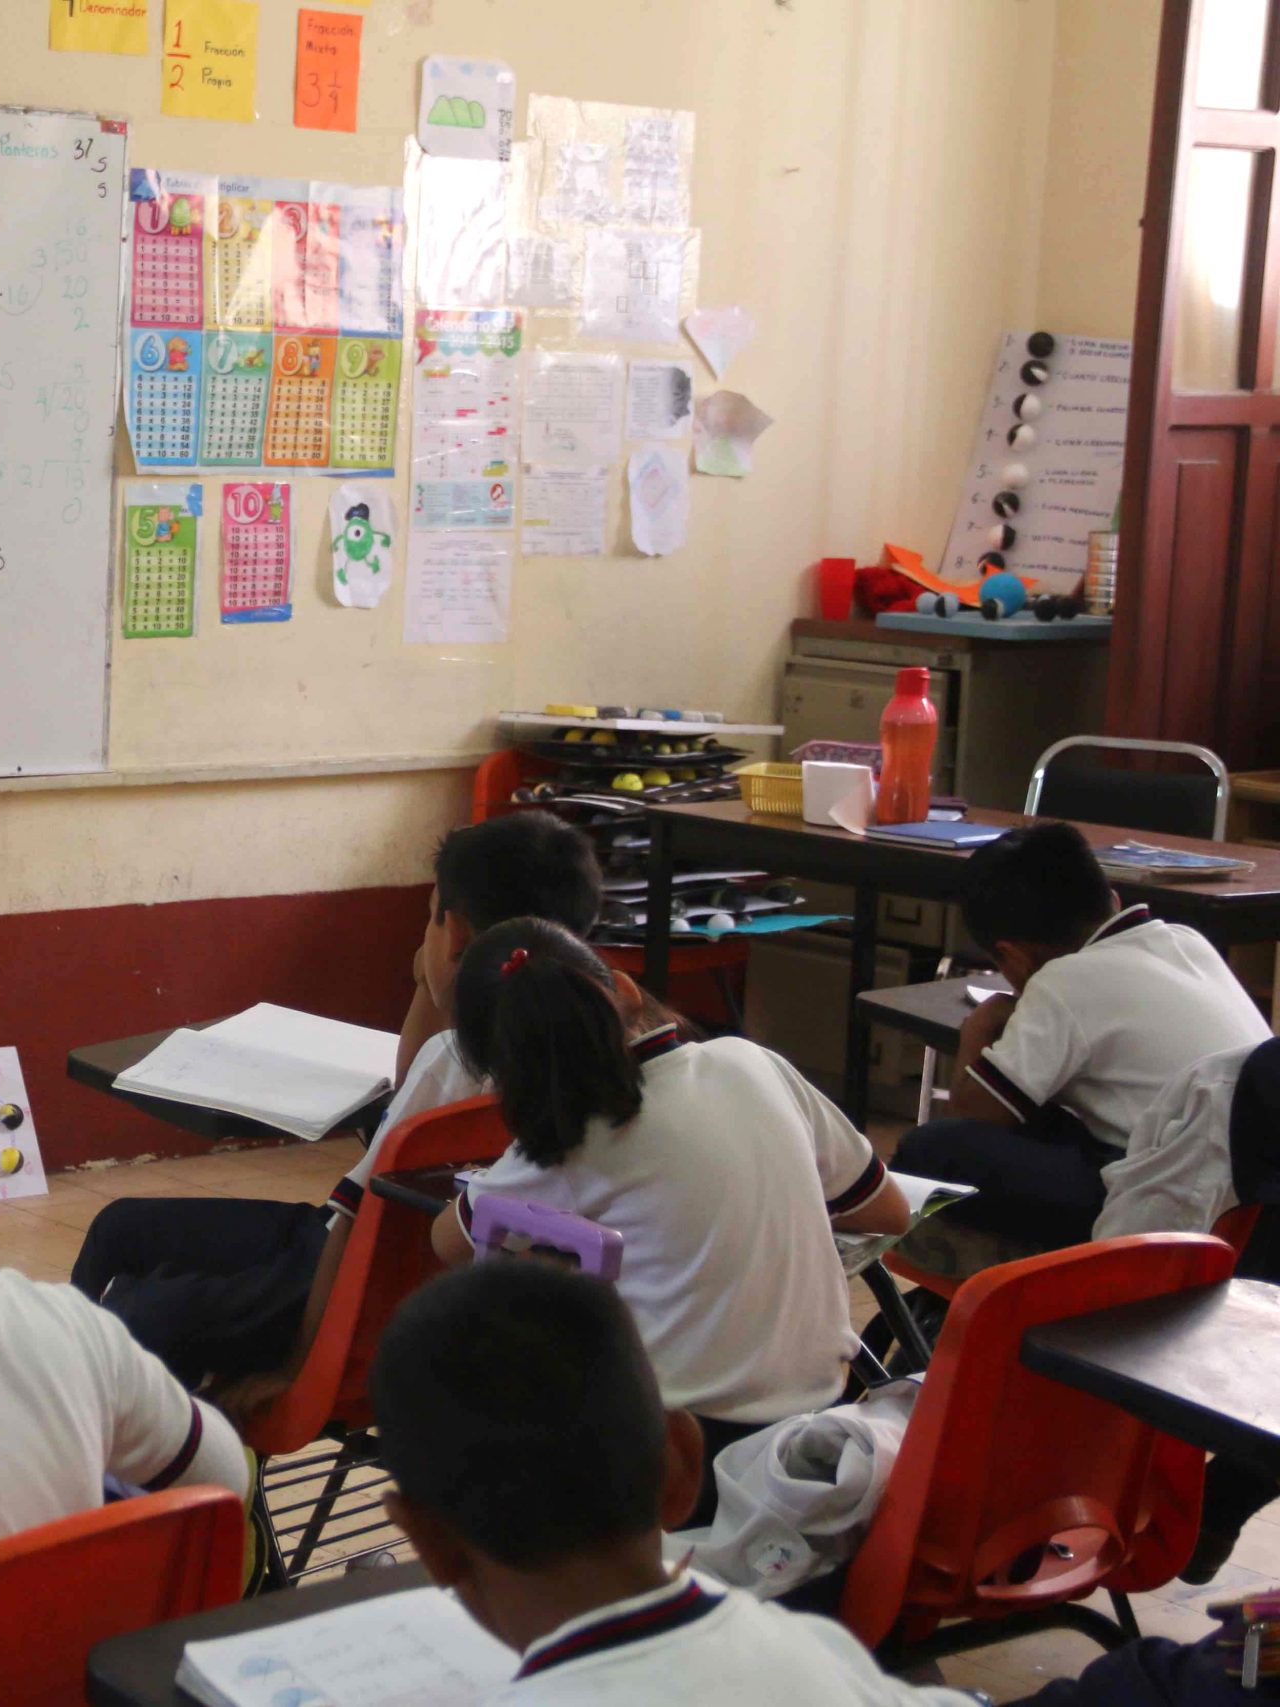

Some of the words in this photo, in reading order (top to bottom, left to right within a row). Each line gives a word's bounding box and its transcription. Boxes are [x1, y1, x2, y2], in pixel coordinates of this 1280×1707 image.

[173, 19, 182, 49] 1
[169, 64, 185, 91] 2
[201, 67, 232, 88] Propia
[302, 73, 321, 108] 3
[139, 334, 160, 365] 6
[282, 341, 300, 372] 8
[345, 341, 364, 374] 9
[136, 507, 156, 539] 5
[230, 491, 261, 518] 10
